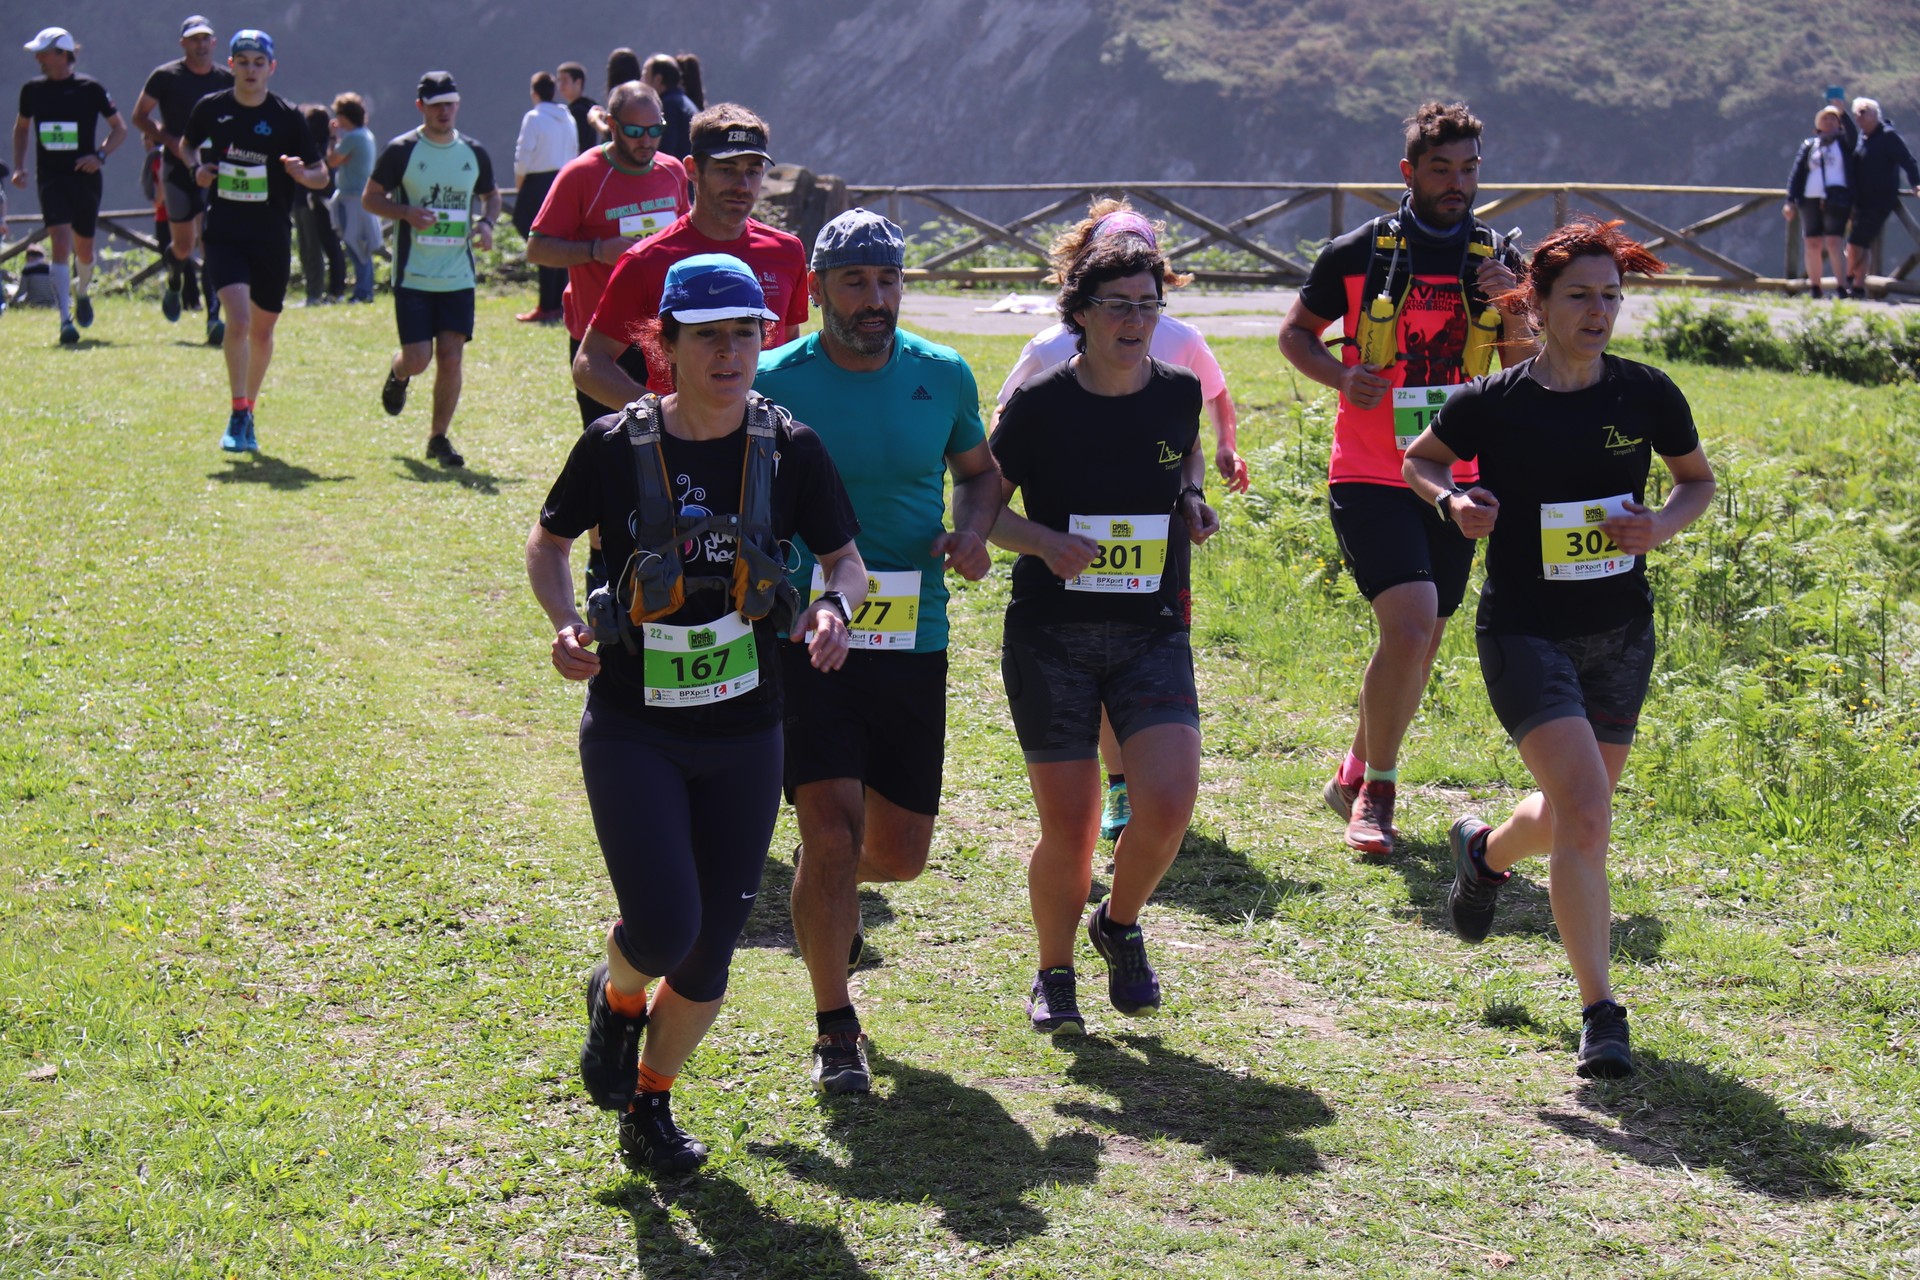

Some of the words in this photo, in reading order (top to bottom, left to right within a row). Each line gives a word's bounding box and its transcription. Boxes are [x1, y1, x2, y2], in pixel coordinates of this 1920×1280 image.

[232, 178, 249, 191] 58
[434, 223, 451, 235] 57
[1397, 391, 1407, 399] 22
[1090, 545, 1142, 570] 301
[650, 628, 663, 639] 22
[670, 648, 730, 682] 167
[679, 688, 710, 697] BPXport
